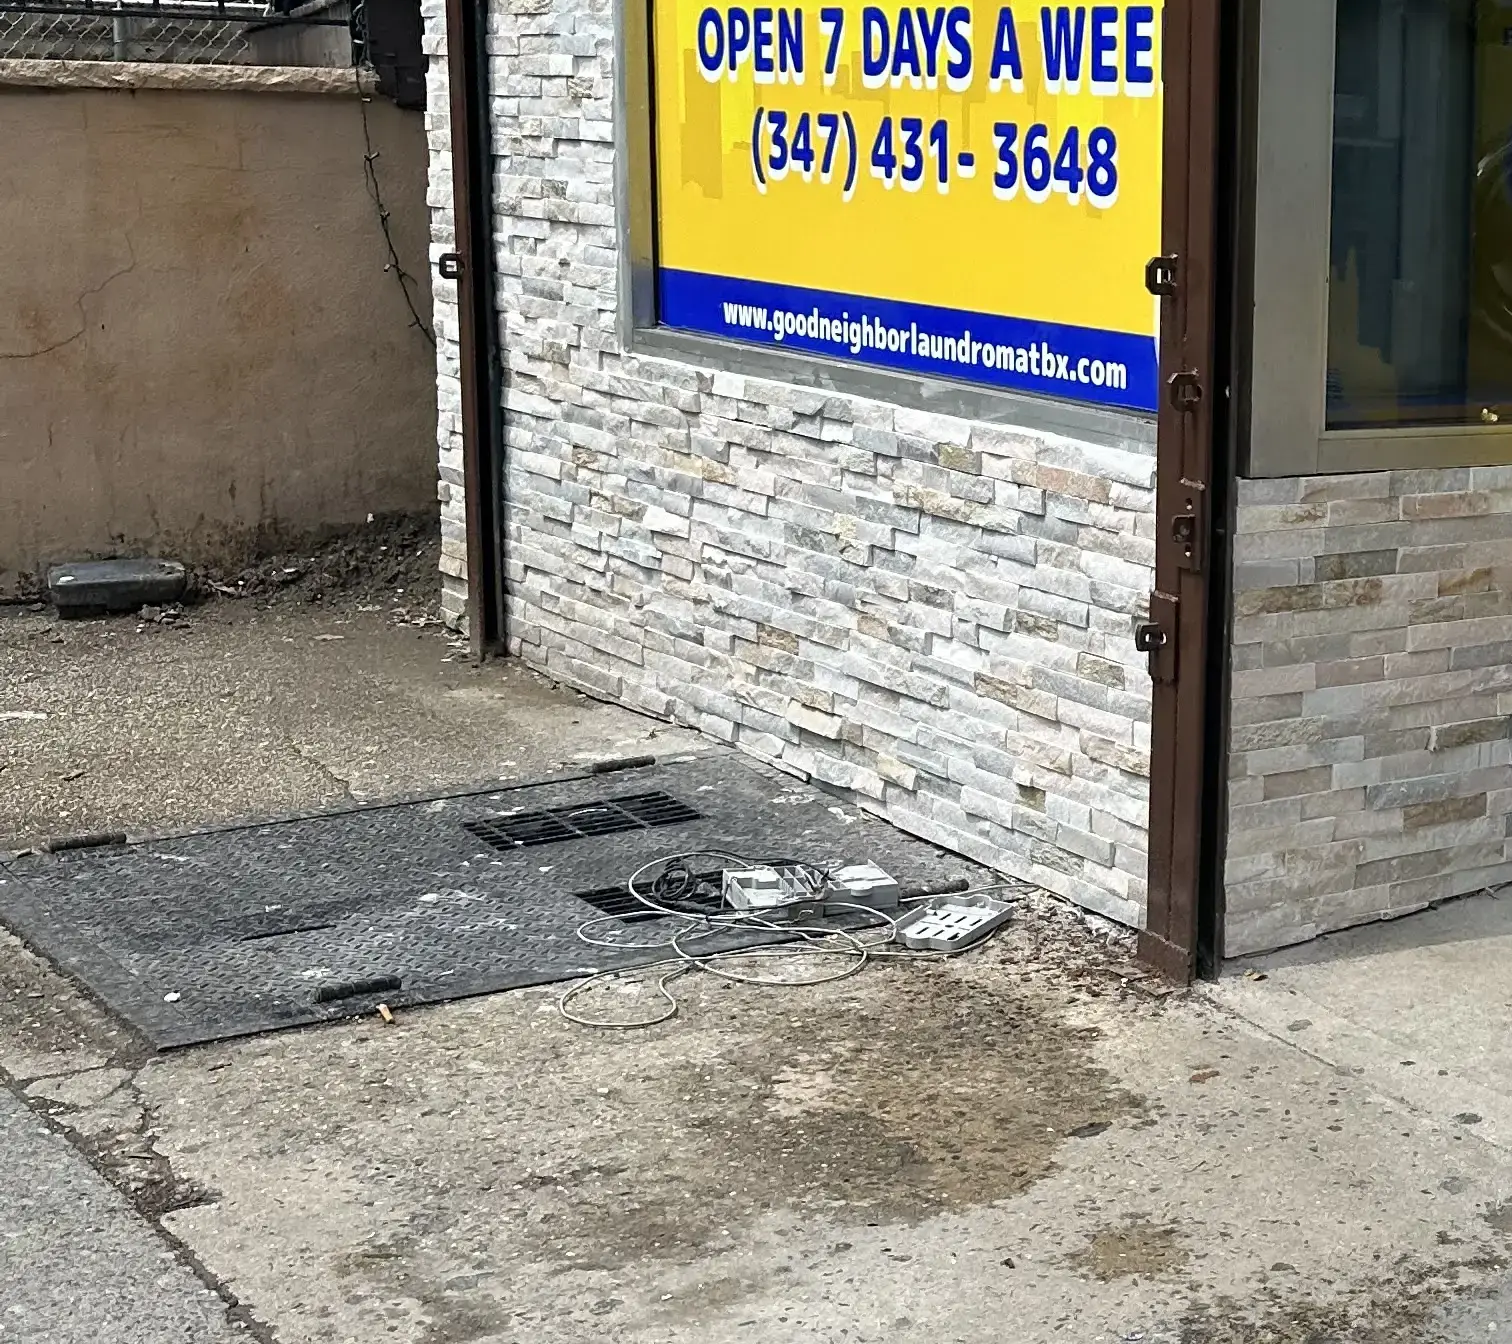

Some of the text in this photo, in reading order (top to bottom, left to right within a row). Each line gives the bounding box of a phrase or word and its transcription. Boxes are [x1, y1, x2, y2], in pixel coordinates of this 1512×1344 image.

[697, 5, 1165, 86] OPEN 7 DAYS A WEE
[751, 105, 859, 194] (347)
[993, 122, 1120, 199] 3648
[722, 298, 1128, 392] www.goodneighborlaundromatbx.com
